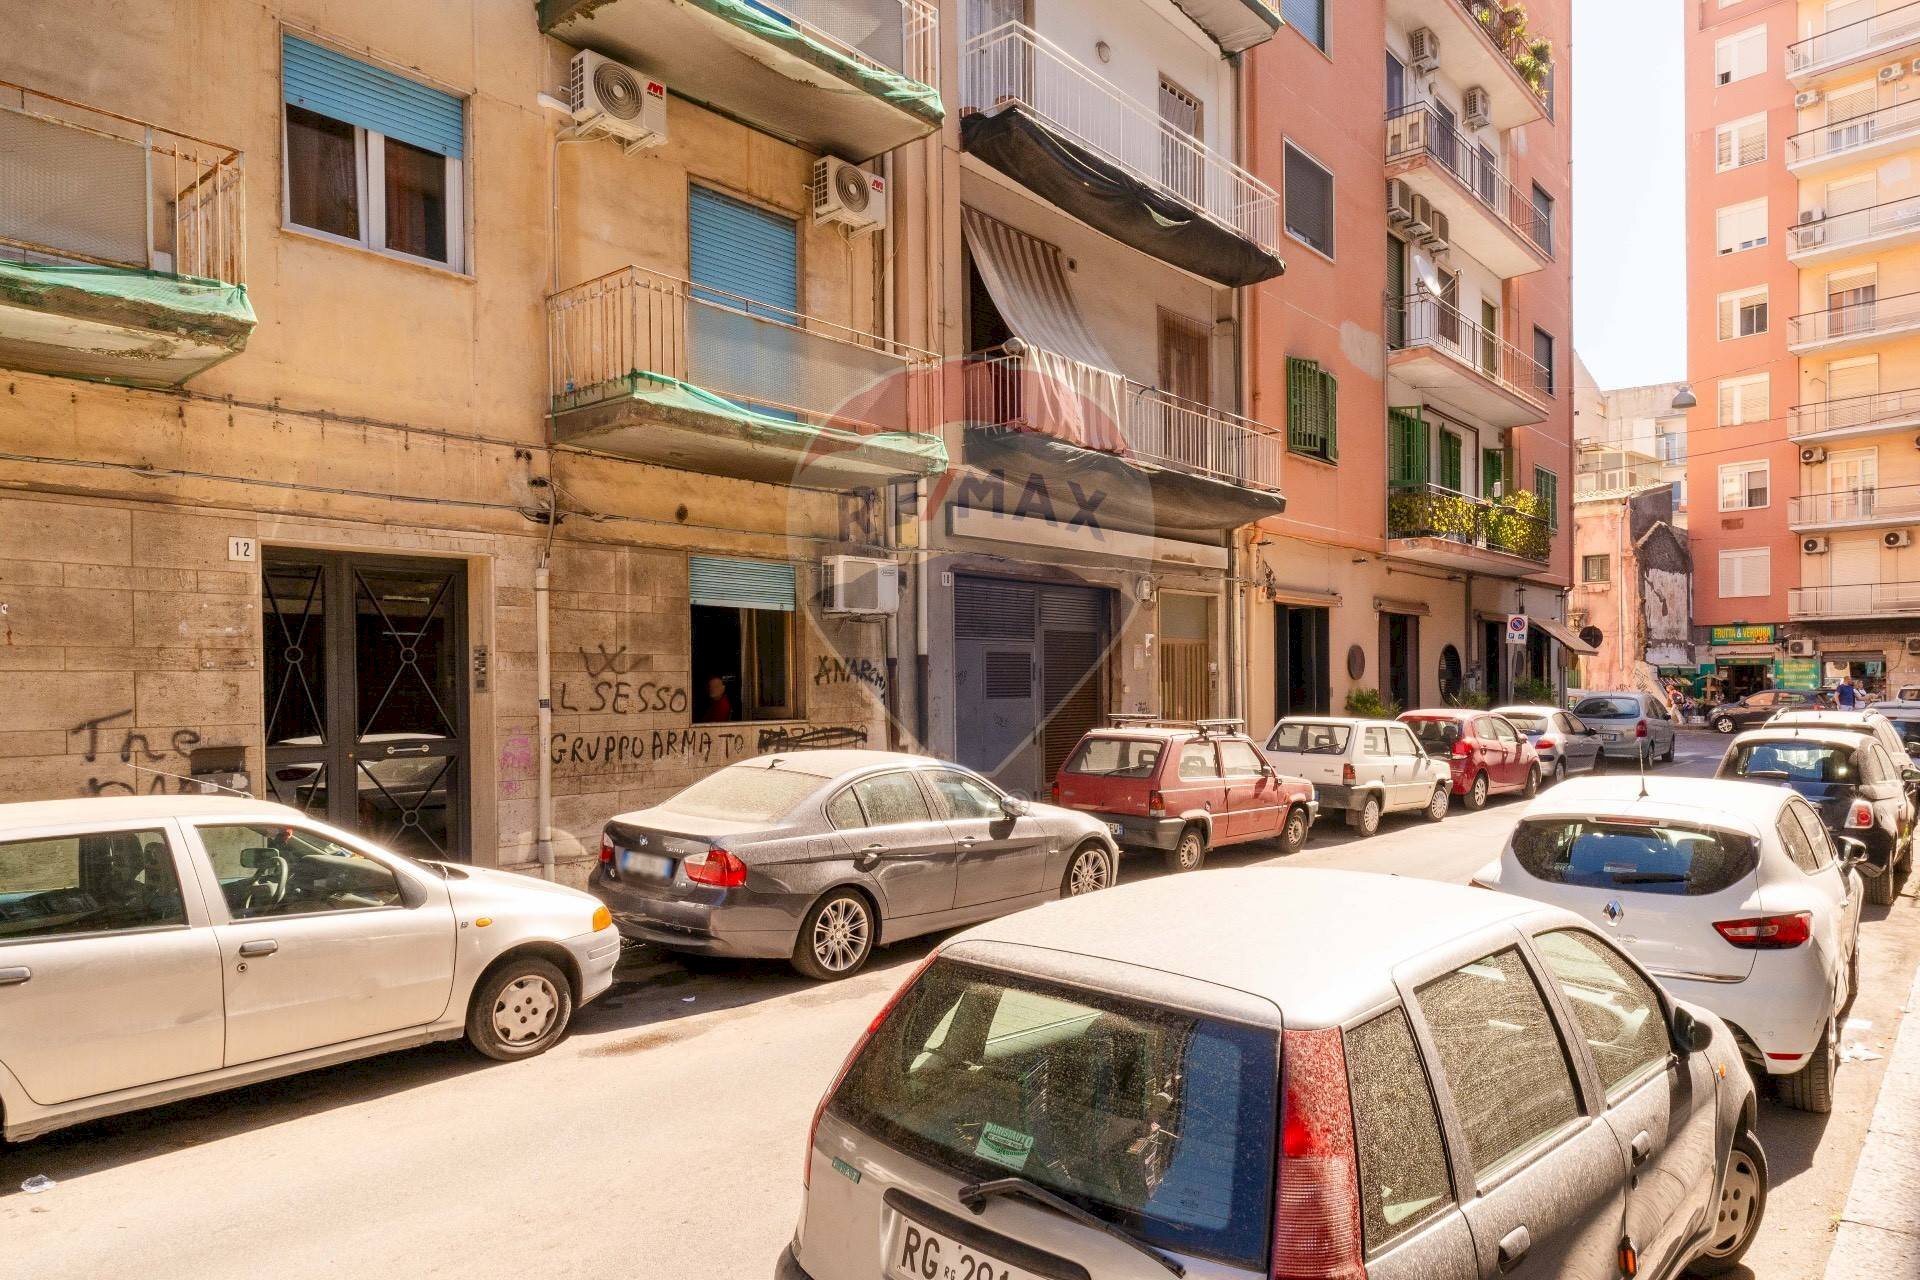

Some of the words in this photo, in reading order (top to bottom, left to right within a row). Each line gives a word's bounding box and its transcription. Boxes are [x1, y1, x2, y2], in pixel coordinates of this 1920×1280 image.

[235, 541, 251, 557] 12
[588, 681, 687, 715] SESSO
[550, 733, 645, 764] GRUPPO
[901, 1226, 940, 1280] RG
